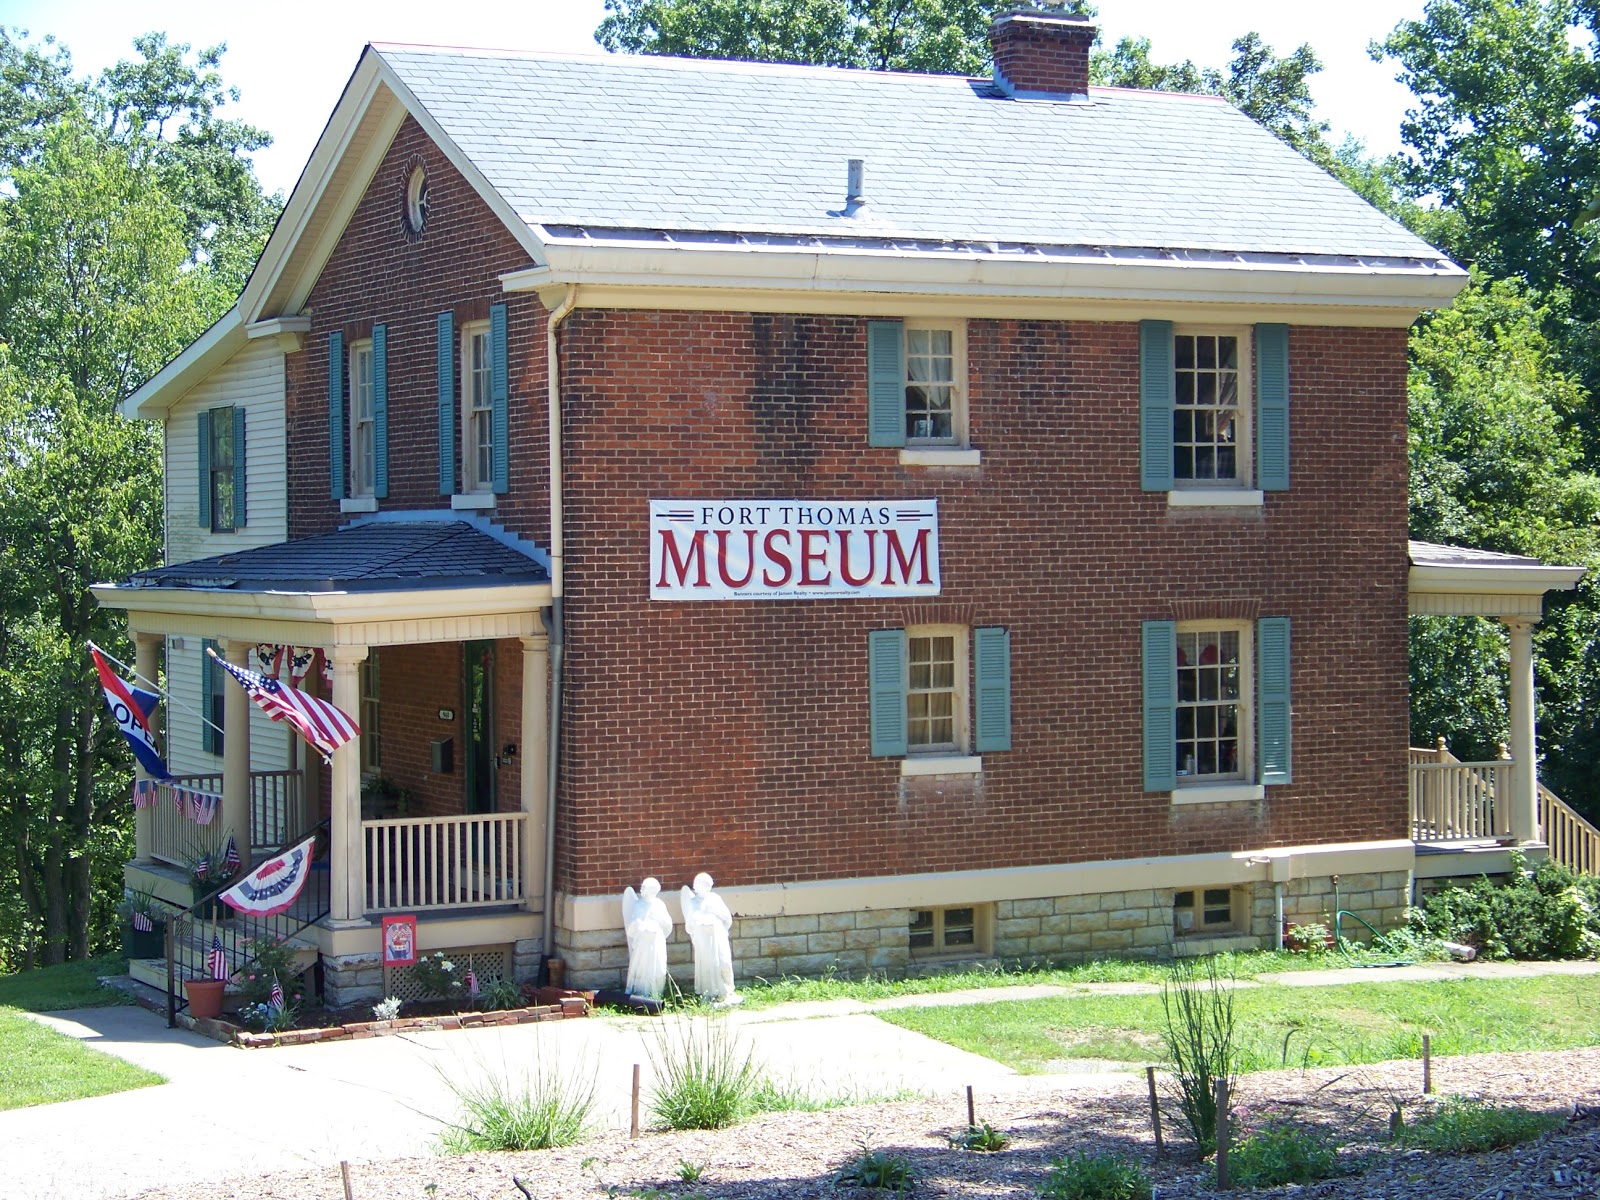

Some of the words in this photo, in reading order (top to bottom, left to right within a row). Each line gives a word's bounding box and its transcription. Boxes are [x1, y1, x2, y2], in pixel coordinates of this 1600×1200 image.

[701, 506, 771, 525] FORT
[779, 506, 891, 525] THOMAS
[656, 528, 934, 588] MUSEUM
